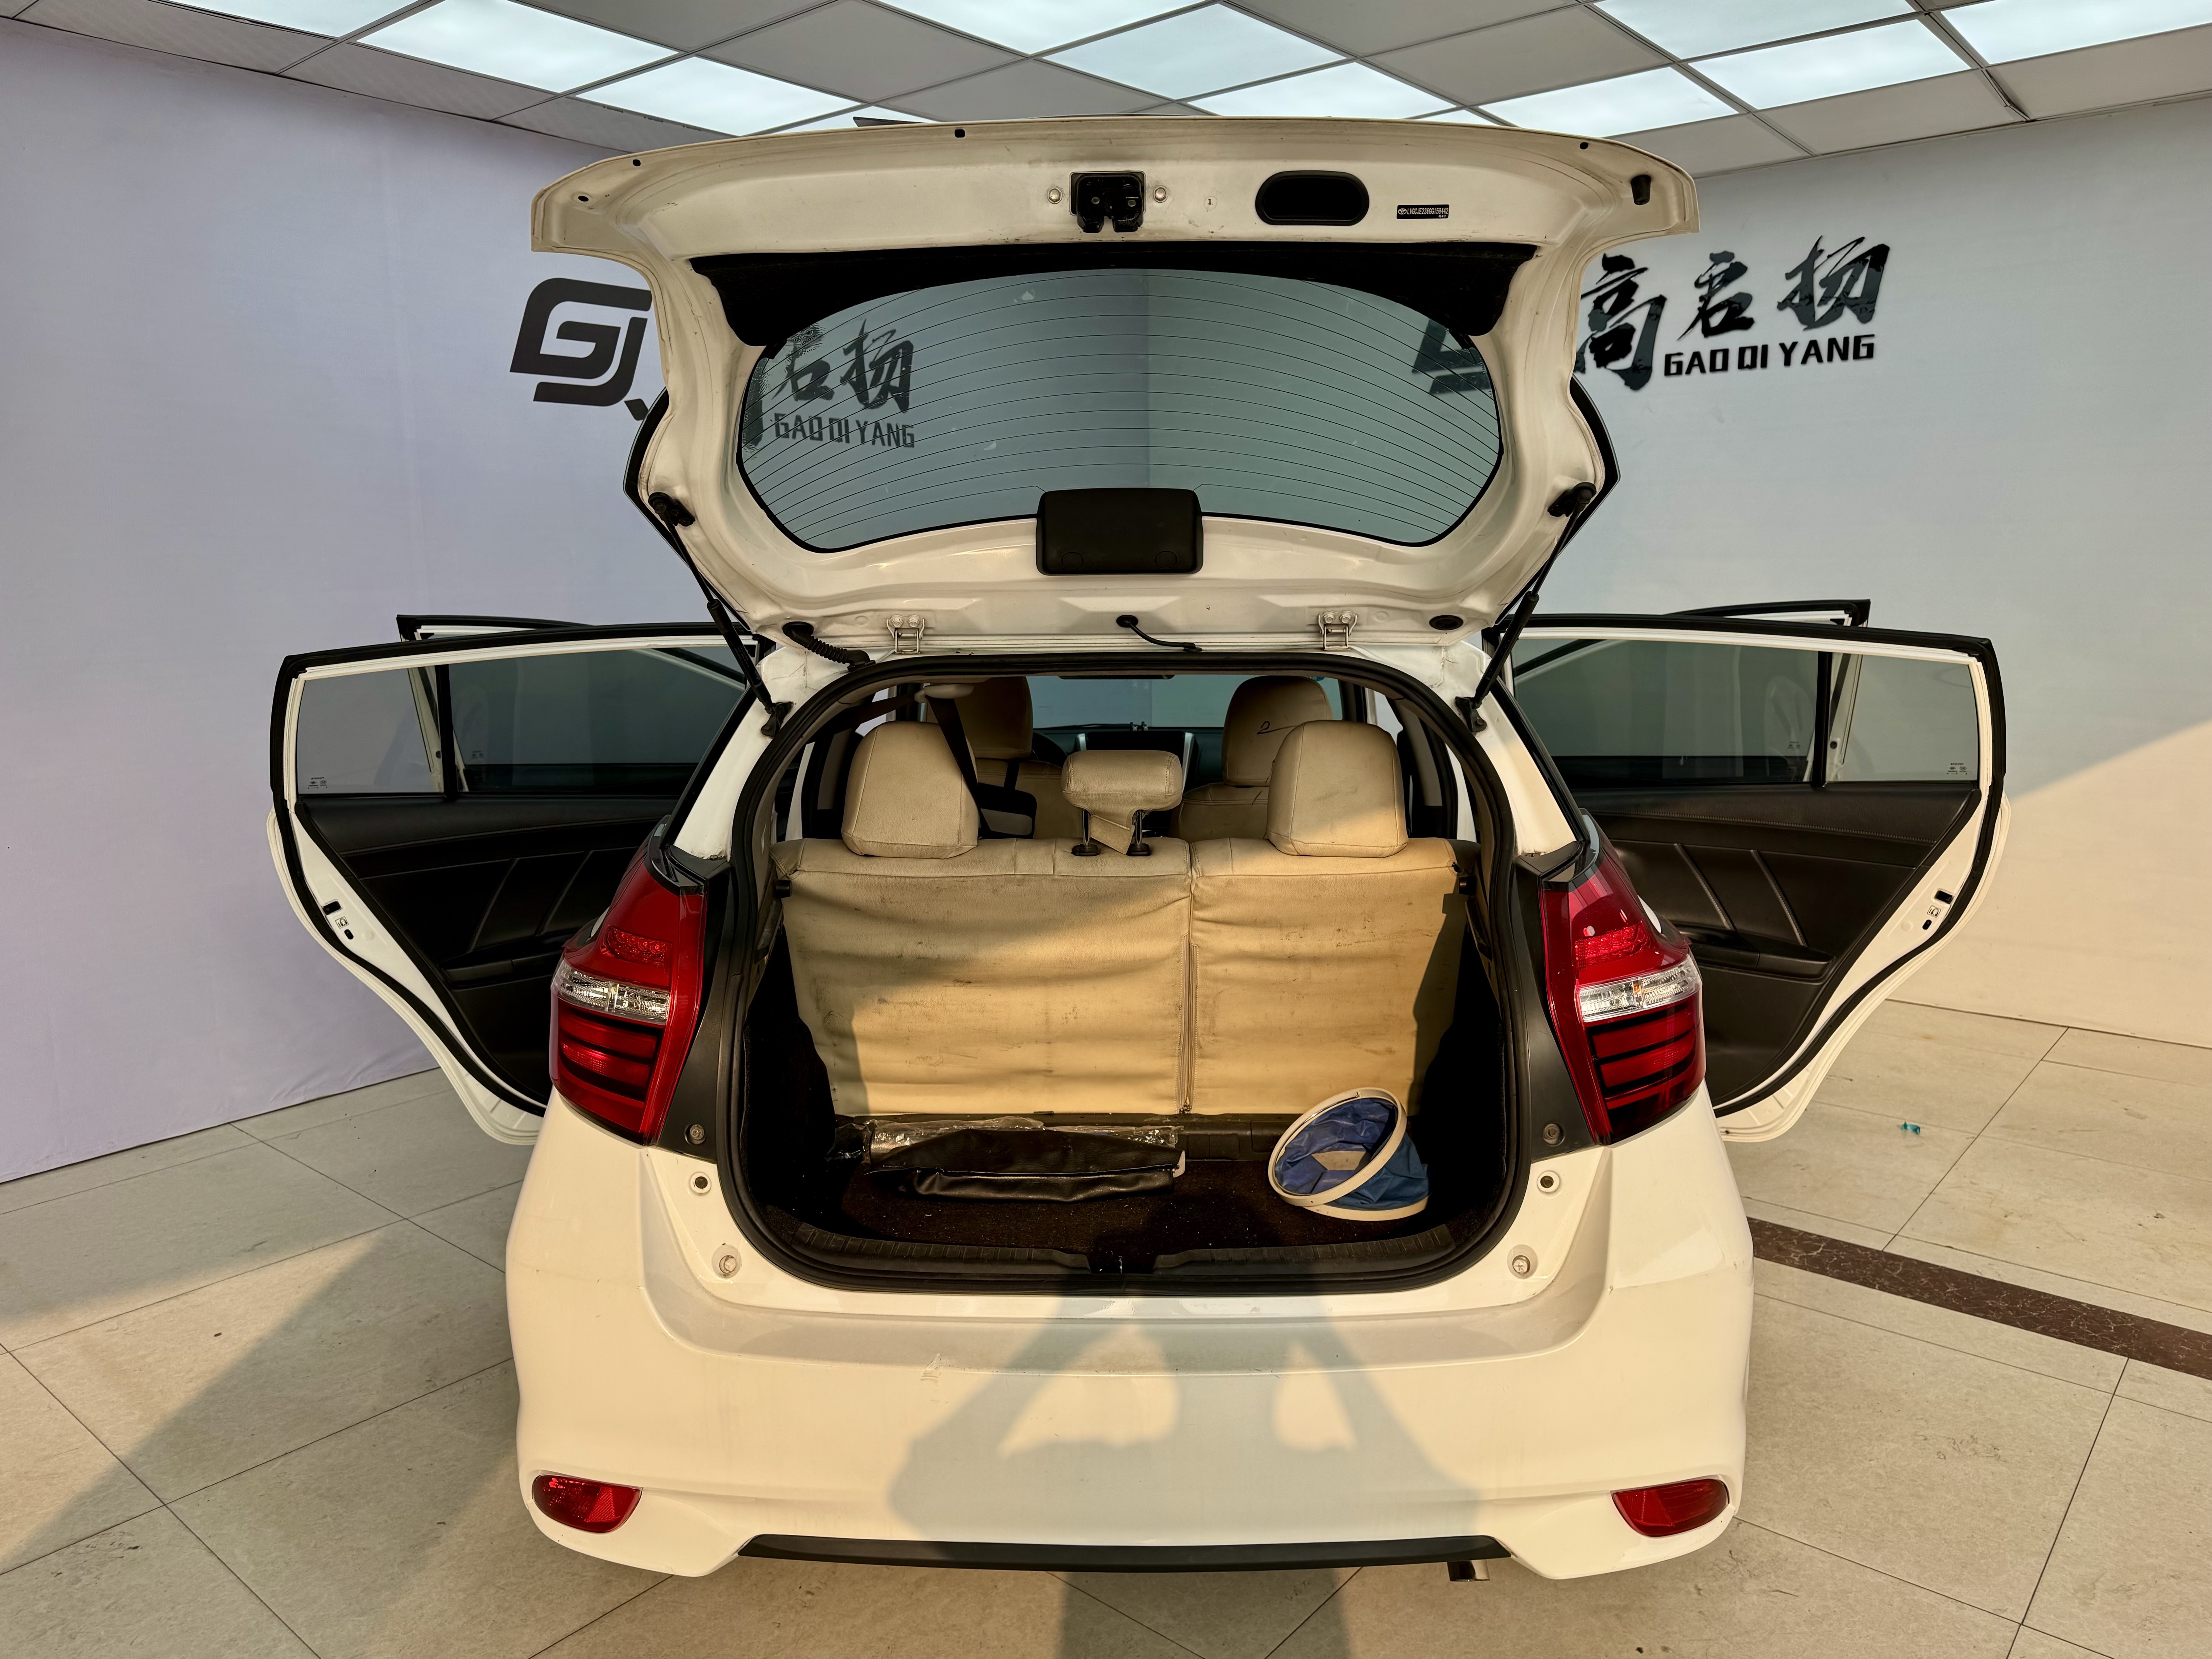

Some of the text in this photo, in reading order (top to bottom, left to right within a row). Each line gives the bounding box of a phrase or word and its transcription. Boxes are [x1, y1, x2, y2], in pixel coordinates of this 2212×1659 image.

[1664, 334, 1875, 376] GAO QI YANG
[775, 413, 823, 442] GAO
[855, 419, 915, 448] YANG
